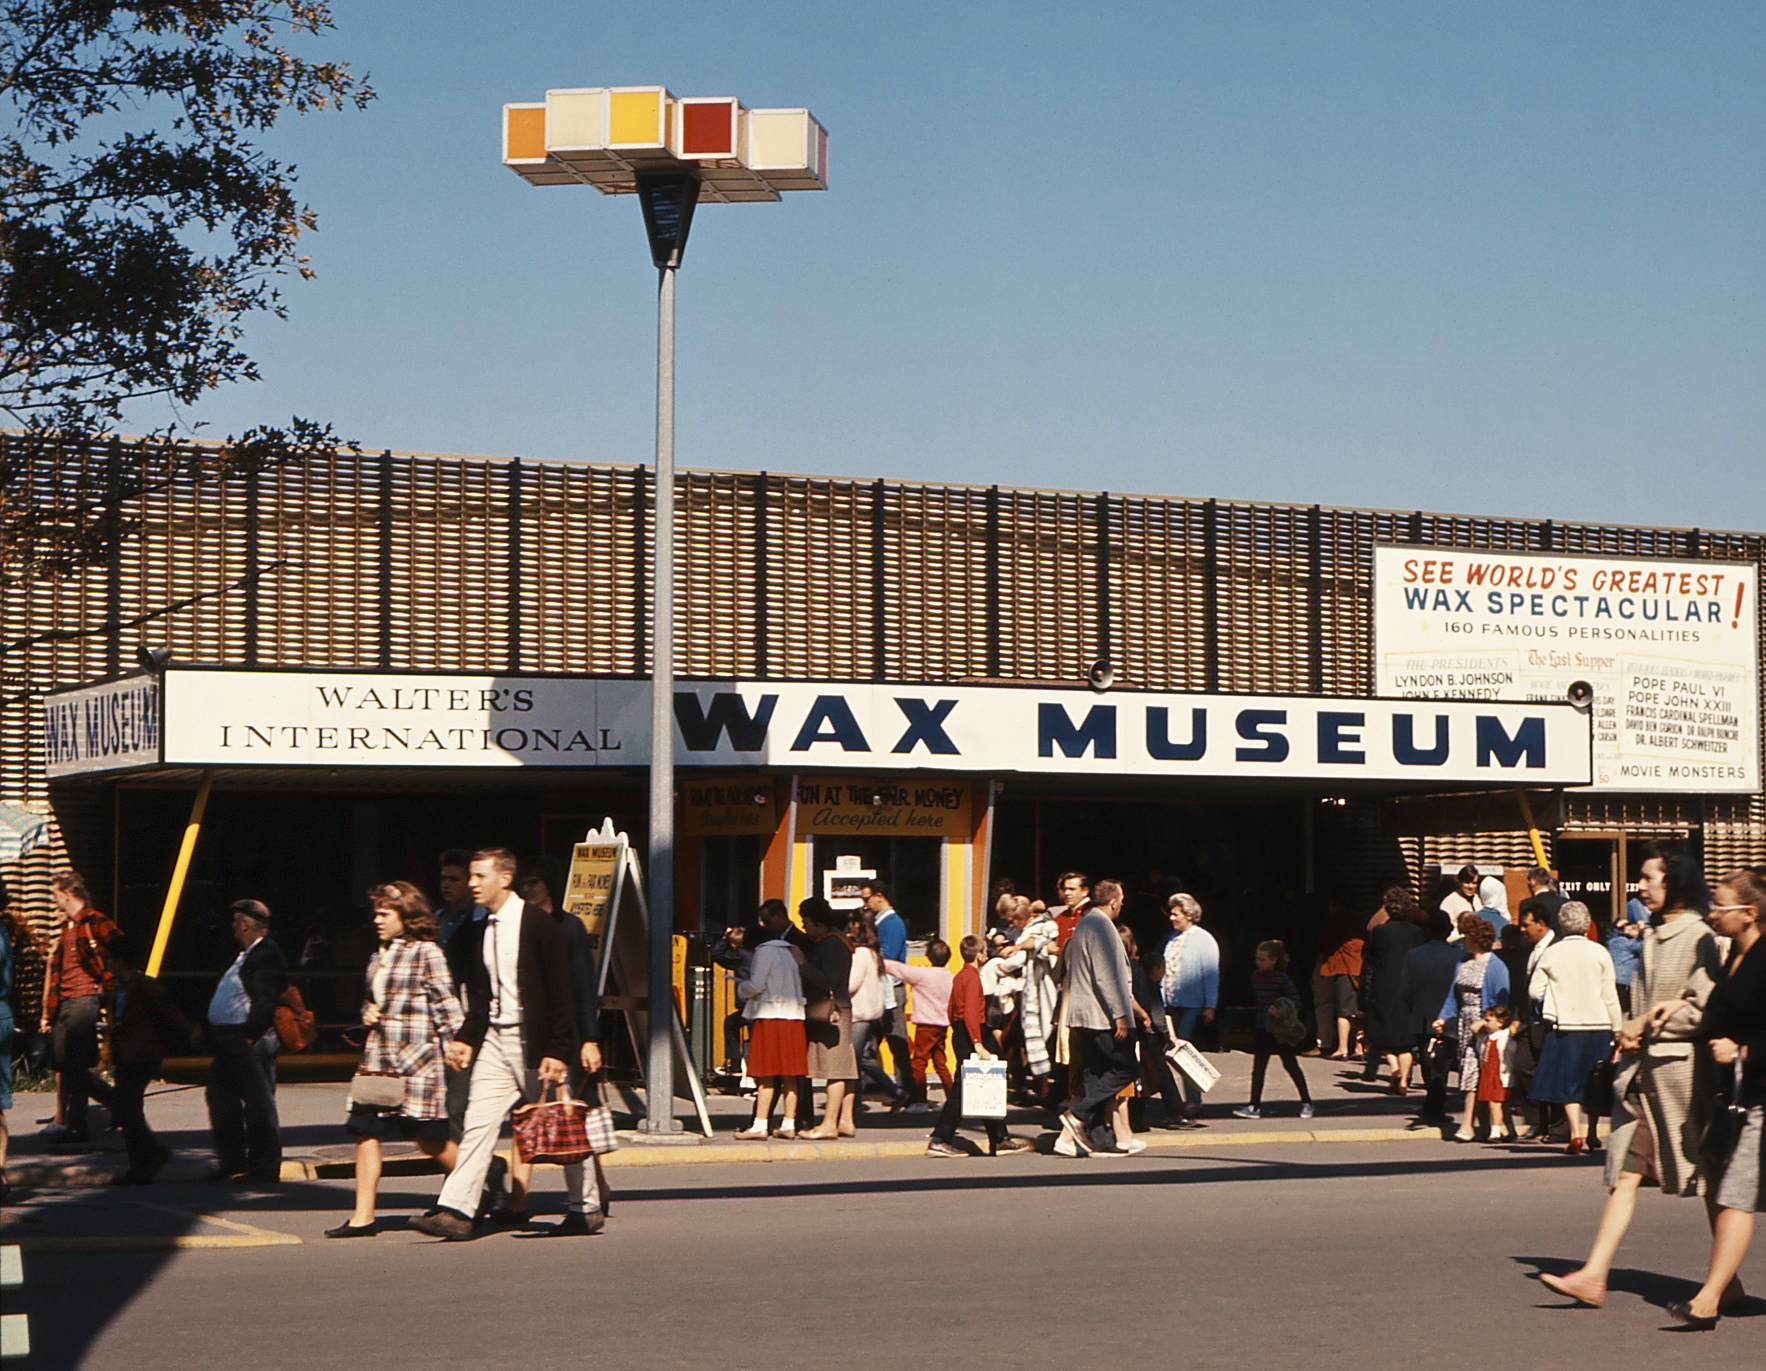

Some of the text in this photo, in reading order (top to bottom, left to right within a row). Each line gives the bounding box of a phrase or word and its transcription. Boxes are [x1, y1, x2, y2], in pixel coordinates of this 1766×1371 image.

[1403, 559, 1724, 595] SEE WORLD'S GREATEST
[1403, 587, 1473, 612] WAX
[1488, 591, 1721, 623] SPECTACULAR
[1445, 622, 1700, 642] 160 FAMOUS PERSONALITIES
[1406, 658, 1508, 671] THE PRESIDENTS
[1528, 649, 1547, 665] The
[1575, 651, 1616, 671] Supper
[1395, 672, 1513, 688] LYNDON B. JOHNSON
[1633, 676, 1724, 698] POPE PAUL VI
[315, 686, 534, 712] WALTER'S
[1444, 688, 1500, 701] KENNEDY
[1629, 690, 1731, 712] POPE JOHN XXIII
[44, 685, 157, 764] WAX MUSEUM
[1626, 705, 1738, 727] FRANCIS CARDINAL SPELLMAN
[1626, 719, 1643, 731] DAVID
[1646, 721, 1657, 732] BEN
[220, 725, 621, 752] INTERNATIONAL
[673, 692, 1546, 769] WAX MUSEUM
[1649, 735, 1678, 748] ALBERT
[1682, 738, 1728, 753] SCHWEITZER
[1620, 765, 1661, 777] MOVIE
[1668, 766, 1745, 779] MONSTERS
[824, 785, 842, 805] AT
[915, 787, 964, 809] MONEY
[812, 807, 944, 831] Accepted here
[1559, 882, 1611, 891] EXIT ONLY
